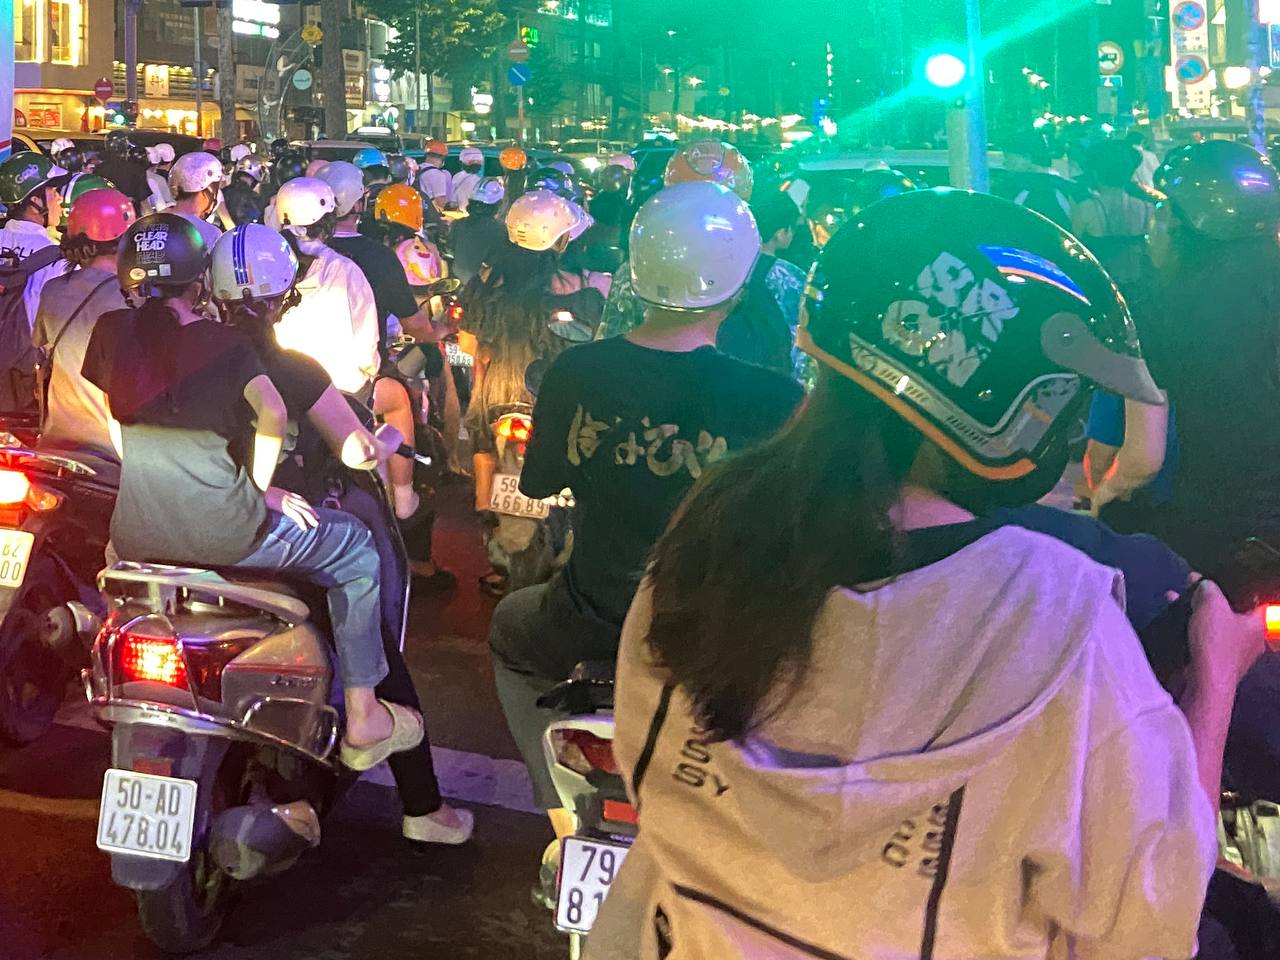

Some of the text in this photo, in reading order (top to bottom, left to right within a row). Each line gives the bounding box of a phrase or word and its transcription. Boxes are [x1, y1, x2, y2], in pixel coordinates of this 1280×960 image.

[134, 231, 168, 243] CLEAR
[136, 241, 165, 252] HEAD
[500, 477, 517, 494] 59
[106, 812, 183, 854] 478.04
[581, 844, 616, 886] 79
